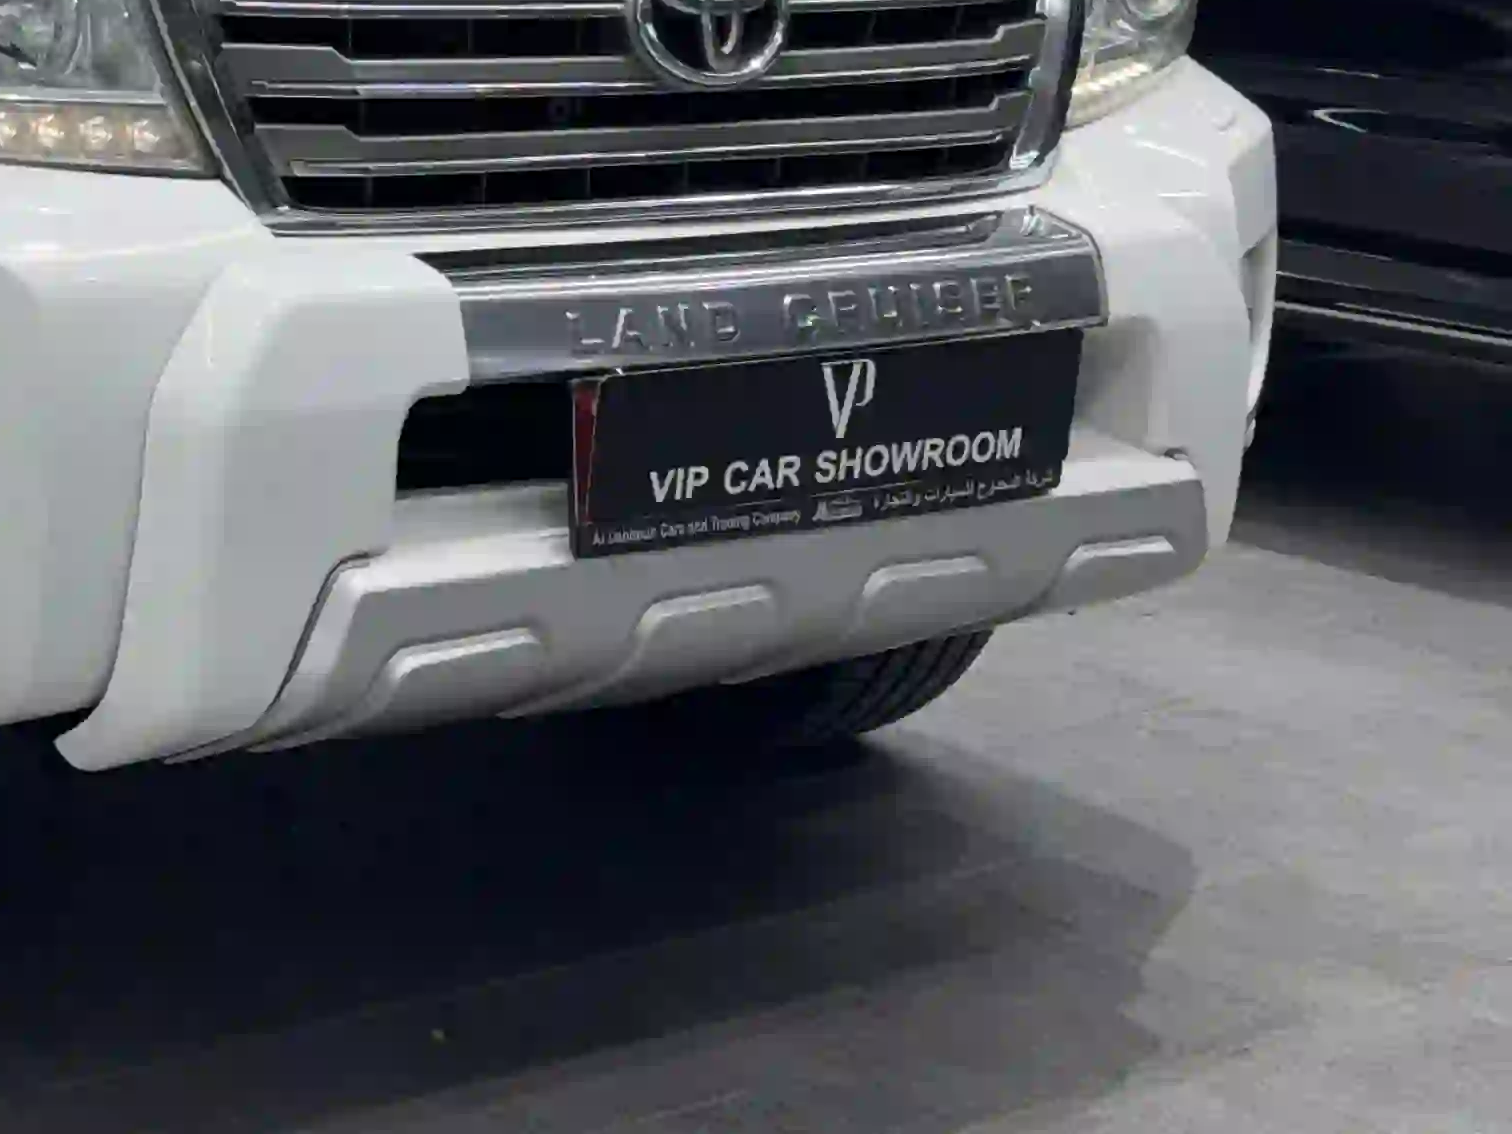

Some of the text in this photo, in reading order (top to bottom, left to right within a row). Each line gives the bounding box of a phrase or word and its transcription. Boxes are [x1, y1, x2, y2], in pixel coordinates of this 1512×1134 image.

[566, 273, 1035, 356] LAND CRUISER
[649, 427, 1023, 503] VIP CAR SHOWROOM
